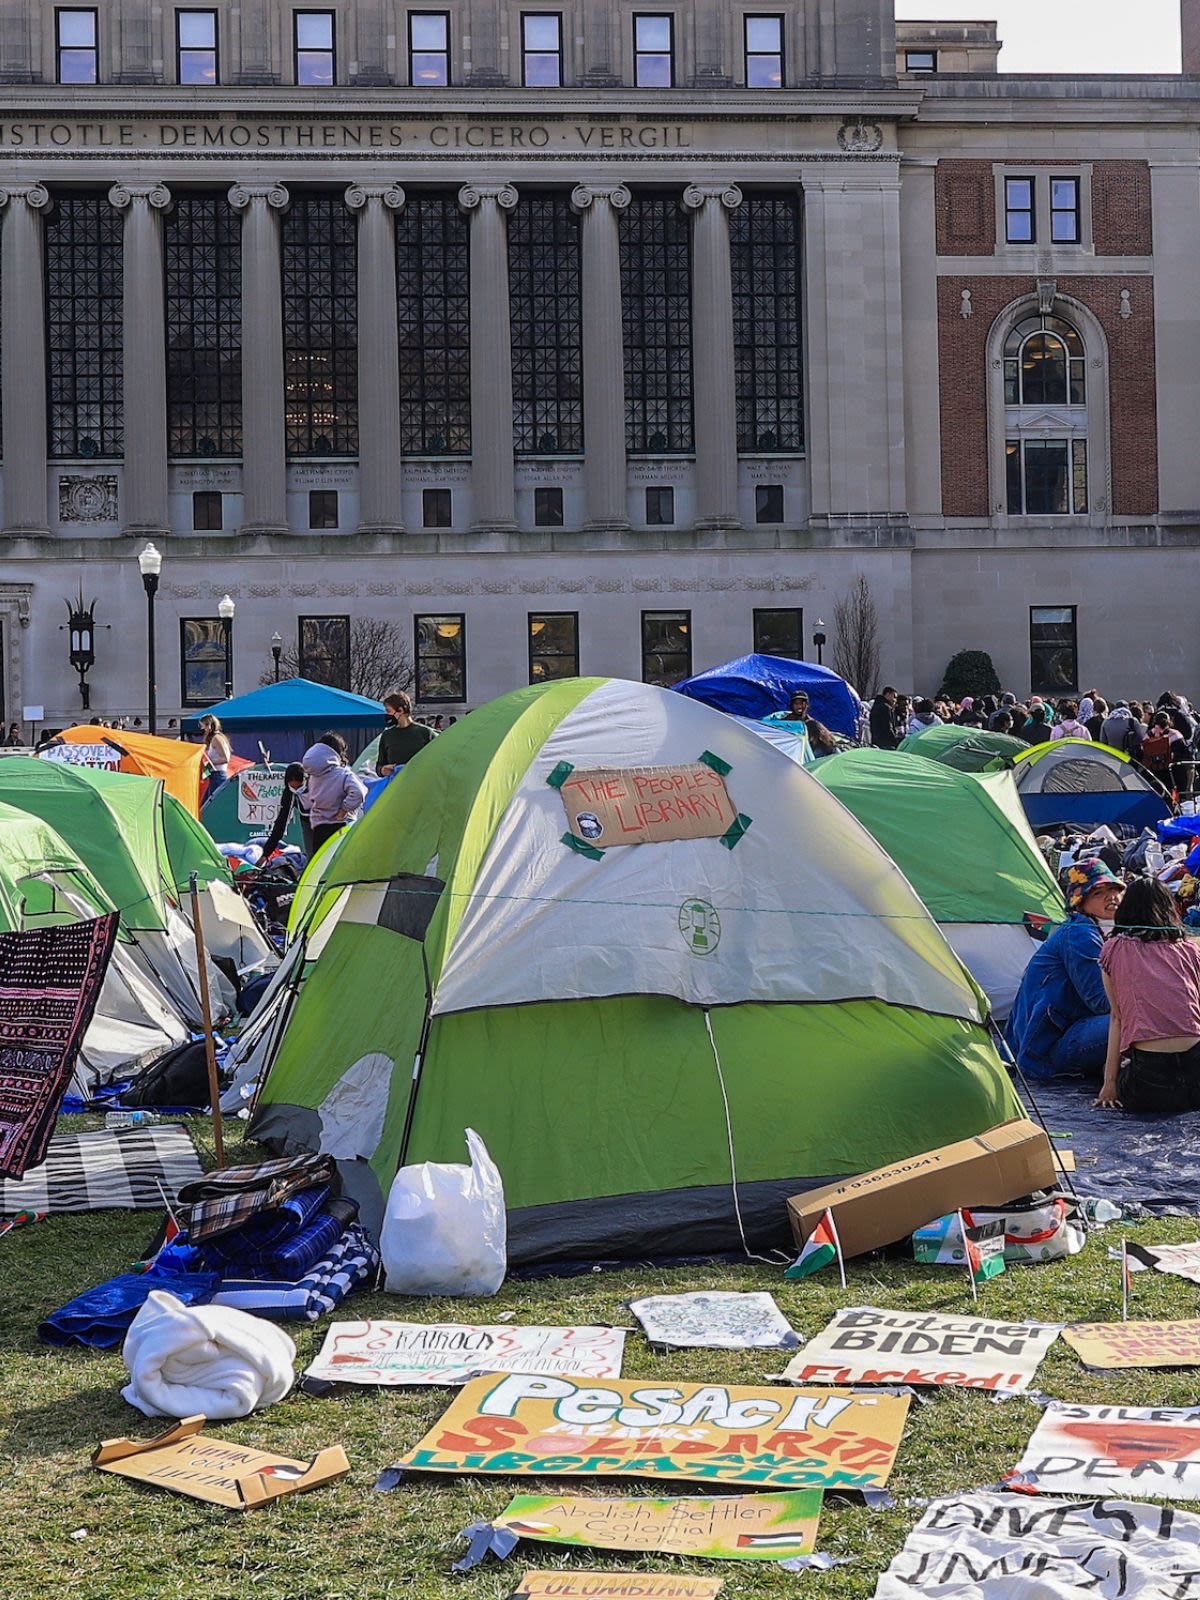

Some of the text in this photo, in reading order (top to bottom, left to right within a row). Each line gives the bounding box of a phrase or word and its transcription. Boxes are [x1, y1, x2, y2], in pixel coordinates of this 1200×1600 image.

[160, 125, 402, 147] DEMOSTHENES
[430, 126, 549, 148] CICERO
[575, 126, 690, 148] VERGIL
[47, 745, 113, 758] PASSOVER
[564, 771, 722, 802] THE PEOPLE'S
[614, 793, 724, 833] LIBRARY
[836, 1311, 1044, 1339] Butcher
[830, 1330, 1027, 1355] BIDEN
[539, 1421, 711, 1441] MEANS
[177, 1442, 265, 1464] WITHIN
[706, 1453, 829, 1468] AND
[189, 1459, 236, 1471] OUR
[542, 1503, 778, 1521] Abolish Settler
[926, 1499, 1174, 1542] DIVEST
[584, 1520, 714, 1536] Colonial
[596, 1533, 700, 1549] States
[896, 1546, 1128, 1597] INVEST
[523, 1573, 717, 1597] COLOMBIANS
